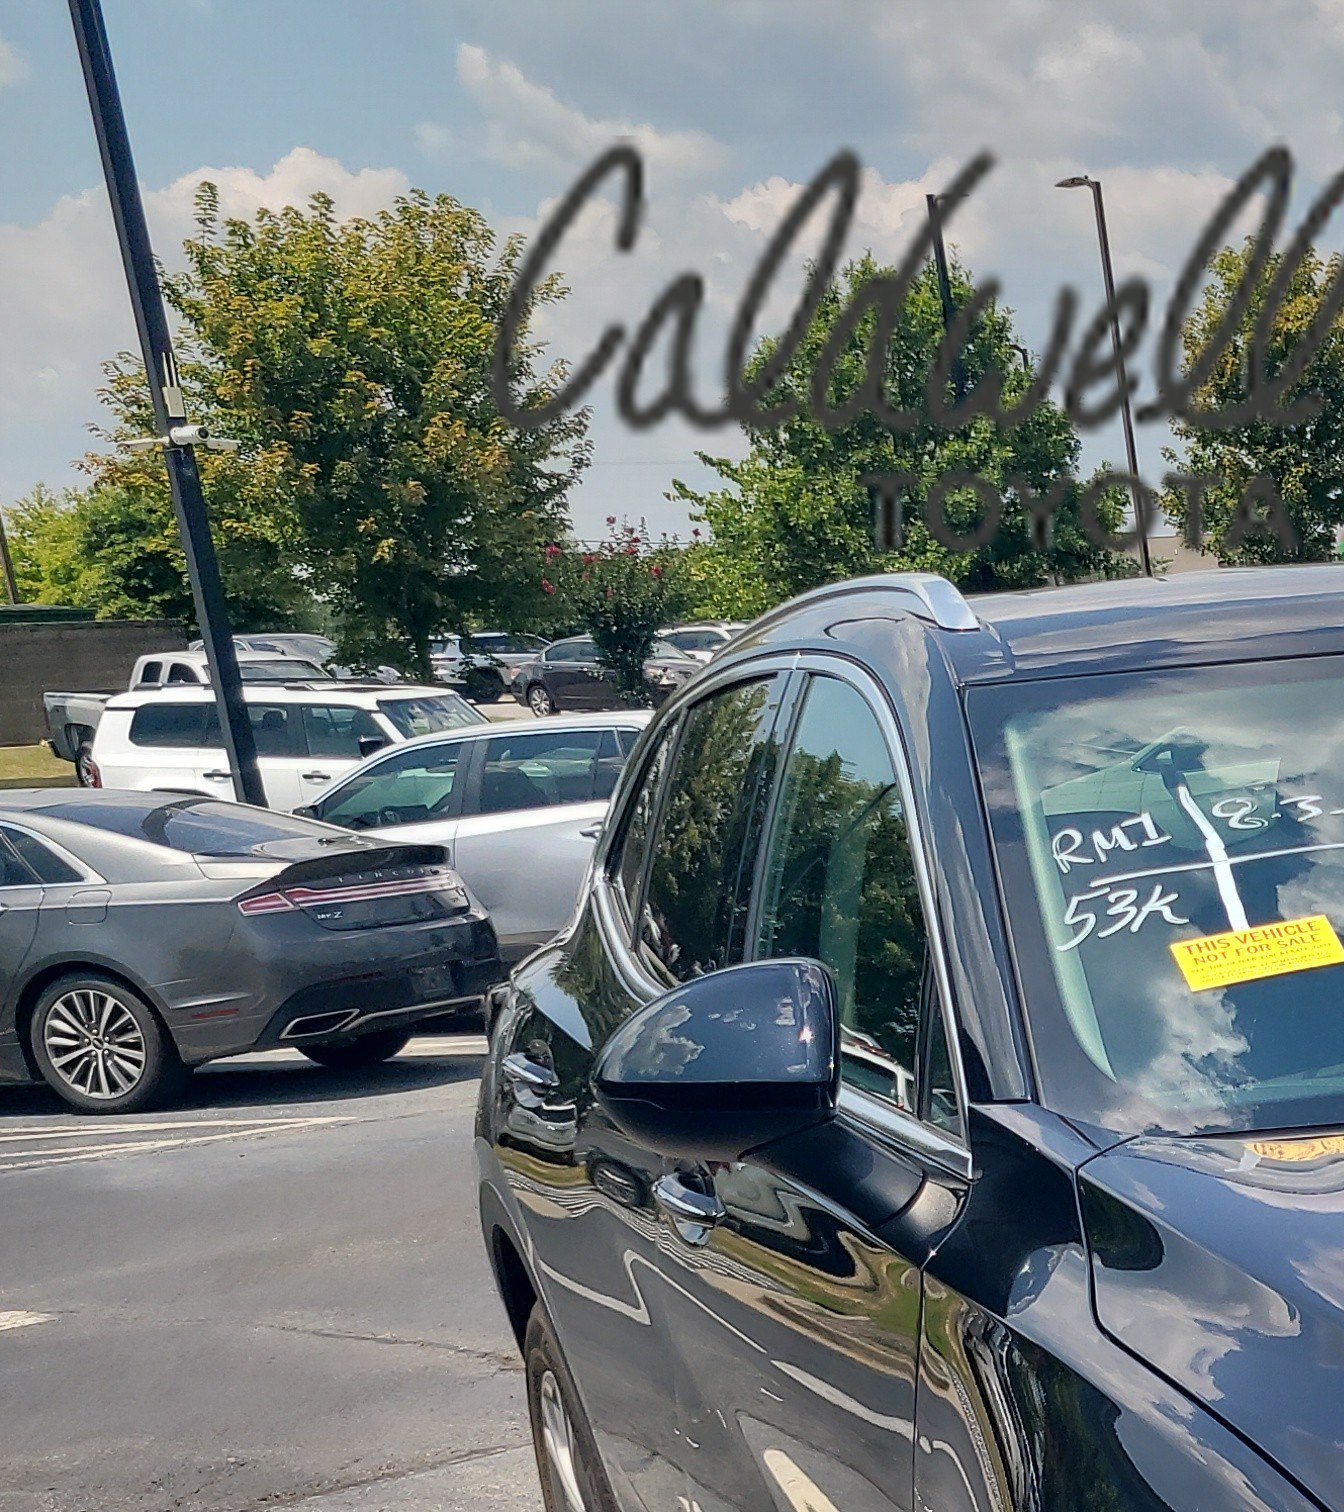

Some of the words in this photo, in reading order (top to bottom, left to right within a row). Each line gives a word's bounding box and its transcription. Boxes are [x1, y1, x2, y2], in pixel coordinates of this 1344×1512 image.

[1182, 937, 1231, 956] THIS
[1234, 920, 1321, 945] VEHICLE
[1193, 951, 1232, 966] NOT
[1235, 943, 1271, 957] FOR
[1276, 933, 1321, 948] SALE
